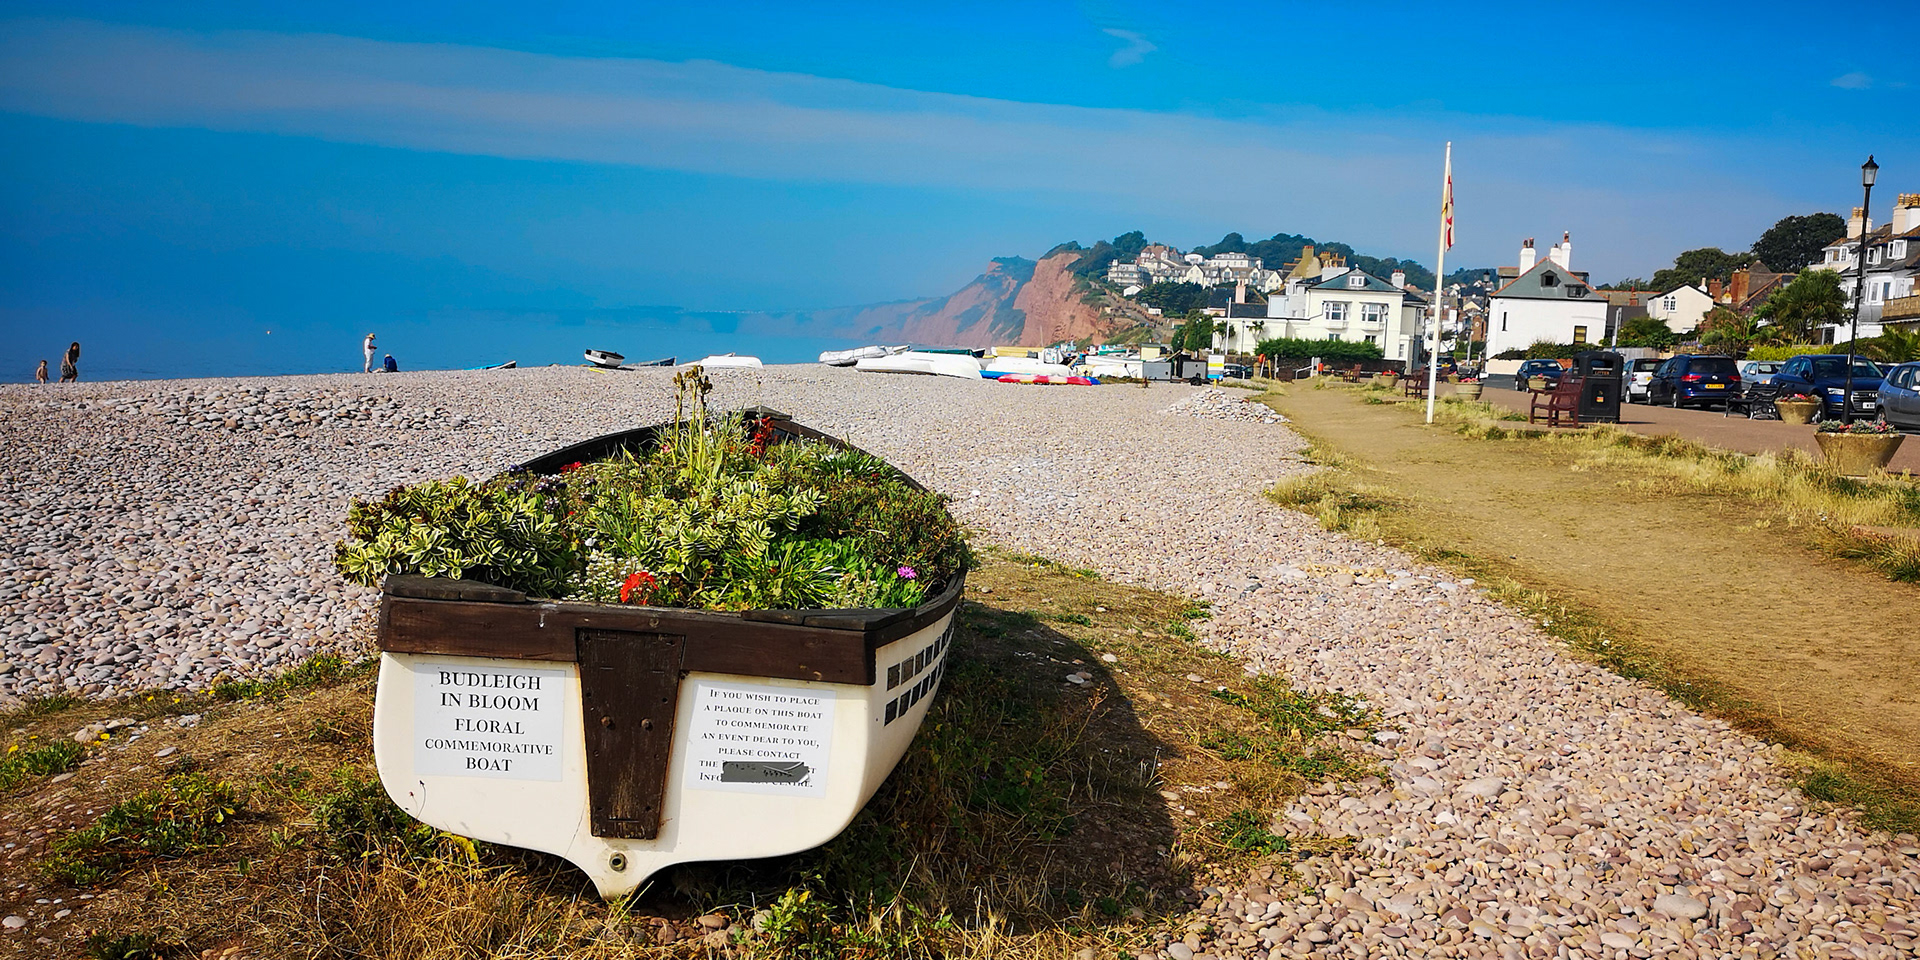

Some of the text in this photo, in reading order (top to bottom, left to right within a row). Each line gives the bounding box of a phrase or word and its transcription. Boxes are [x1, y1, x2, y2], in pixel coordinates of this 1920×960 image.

[439, 671, 541, 690] BUDLEIGH
[441, 693, 539, 711] IN BLOOM
[710, 690, 720, 698] IF
[746, 694, 771, 702] WISH
[714, 706, 752, 714] PLAQUE
[455, 718, 525, 735] FLORAL
[731, 720, 809, 732] COMMEMORATE
[425, 739, 553, 755] COMMEMORATIVE
[718, 734, 750, 742] EVENT
[798, 739, 820, 748] YOU,
[718, 748, 801, 759] PLEASE CONTACT
[466, 757, 512, 771] BOAT
[699, 760, 718, 768] THE
